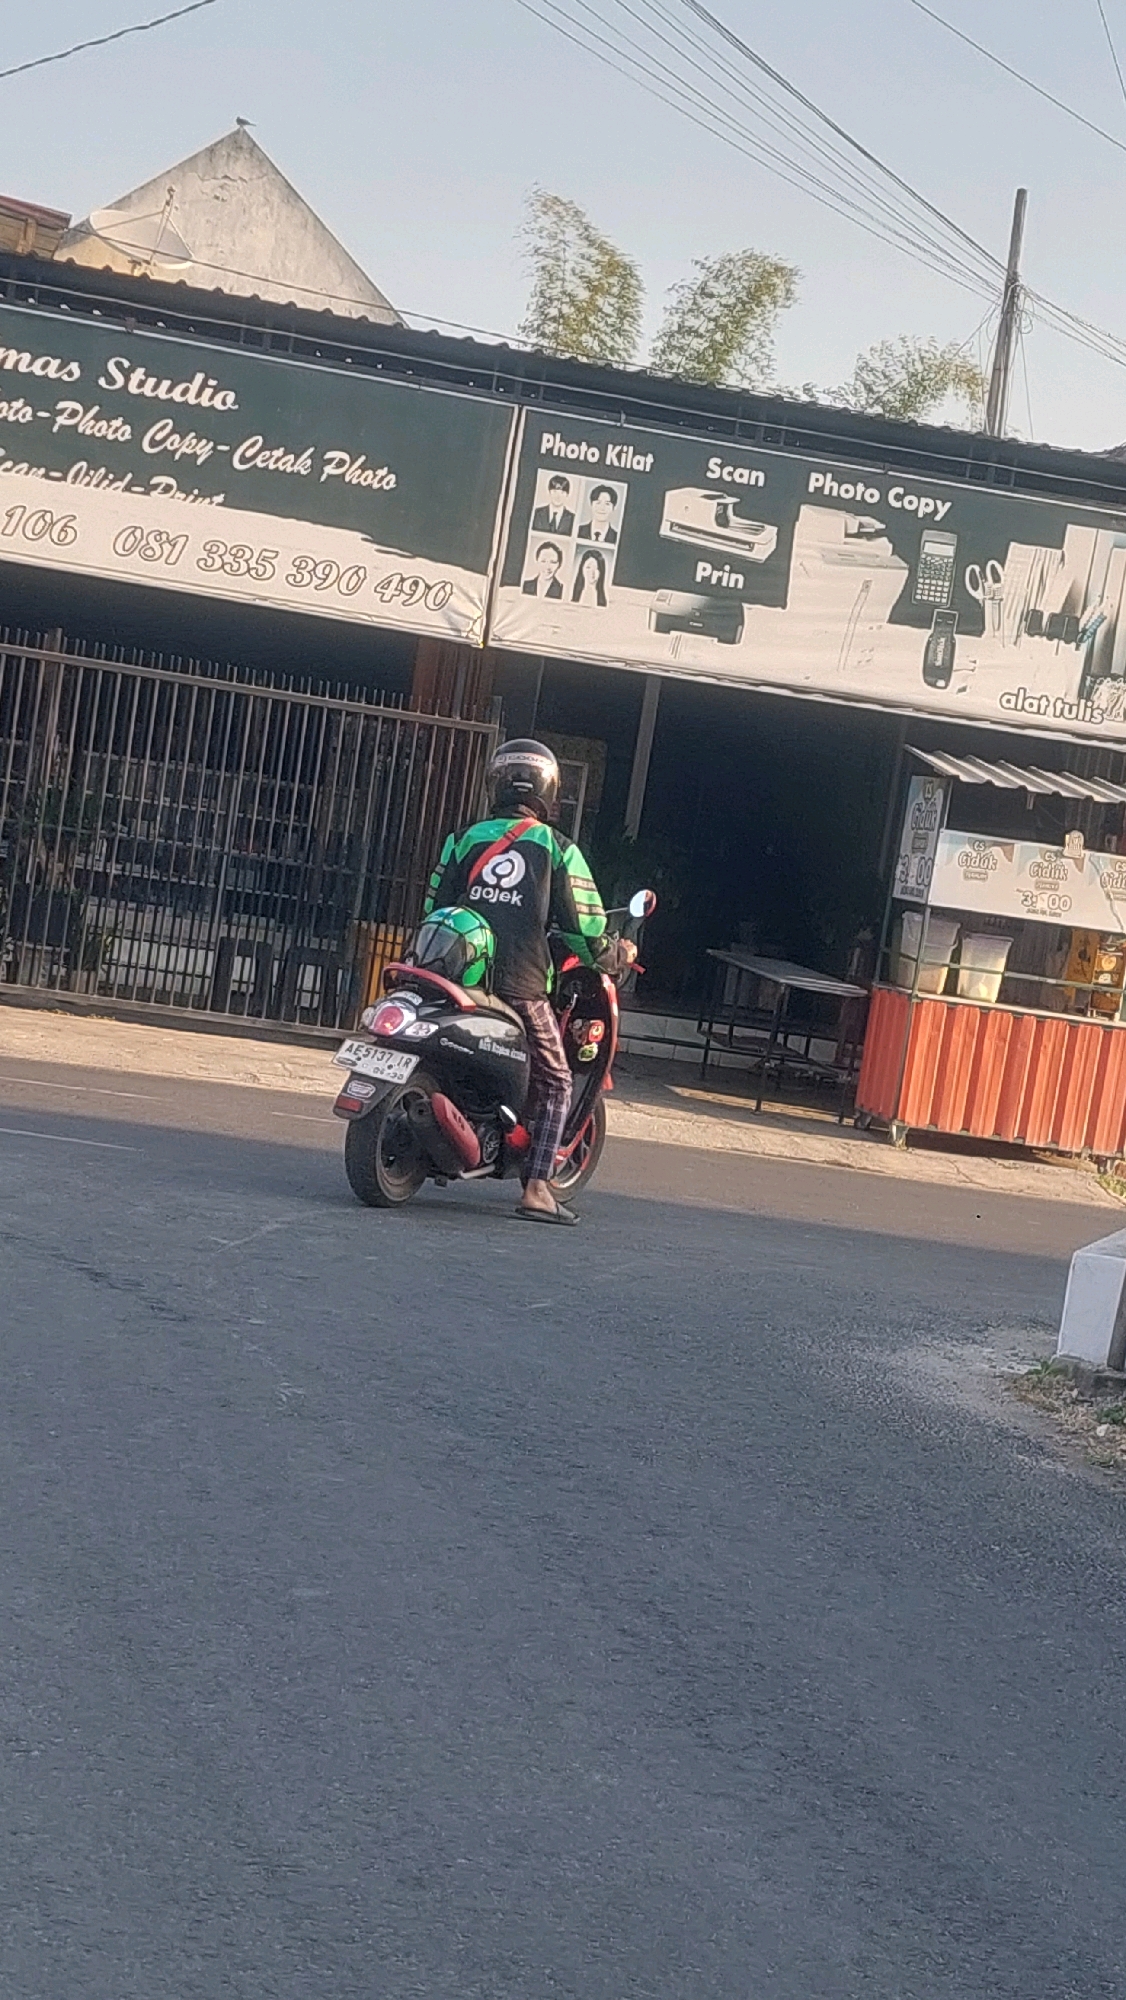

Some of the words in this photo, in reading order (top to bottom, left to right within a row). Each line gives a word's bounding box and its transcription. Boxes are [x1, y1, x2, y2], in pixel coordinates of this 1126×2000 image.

[98, 357, 239, 410] Studio
[320, 450, 398, 491] Photo
[539, 432, 600, 465] Photo
[605, 444, 655, 473] Kilat
[706, 457, 766, 488] Scan
[808, 472, 881, 506] Photo
[886, 487, 952, 521] Copy
[1, 505, 79, 546] 106
[112, 525, 189, 566] 081
[196, 540, 279, 581] 335
[286, 555, 368, 596] 390
[374, 571, 454, 612] 490
[694, 562, 745, 590] Prin
[999, 687, 1050, 716] alat
[1052, 697, 1105, 725] tulis
[973, 840, 986, 851] CS
[1044, 851, 1057, 863] CS
[469, 884, 524, 907] gojek
